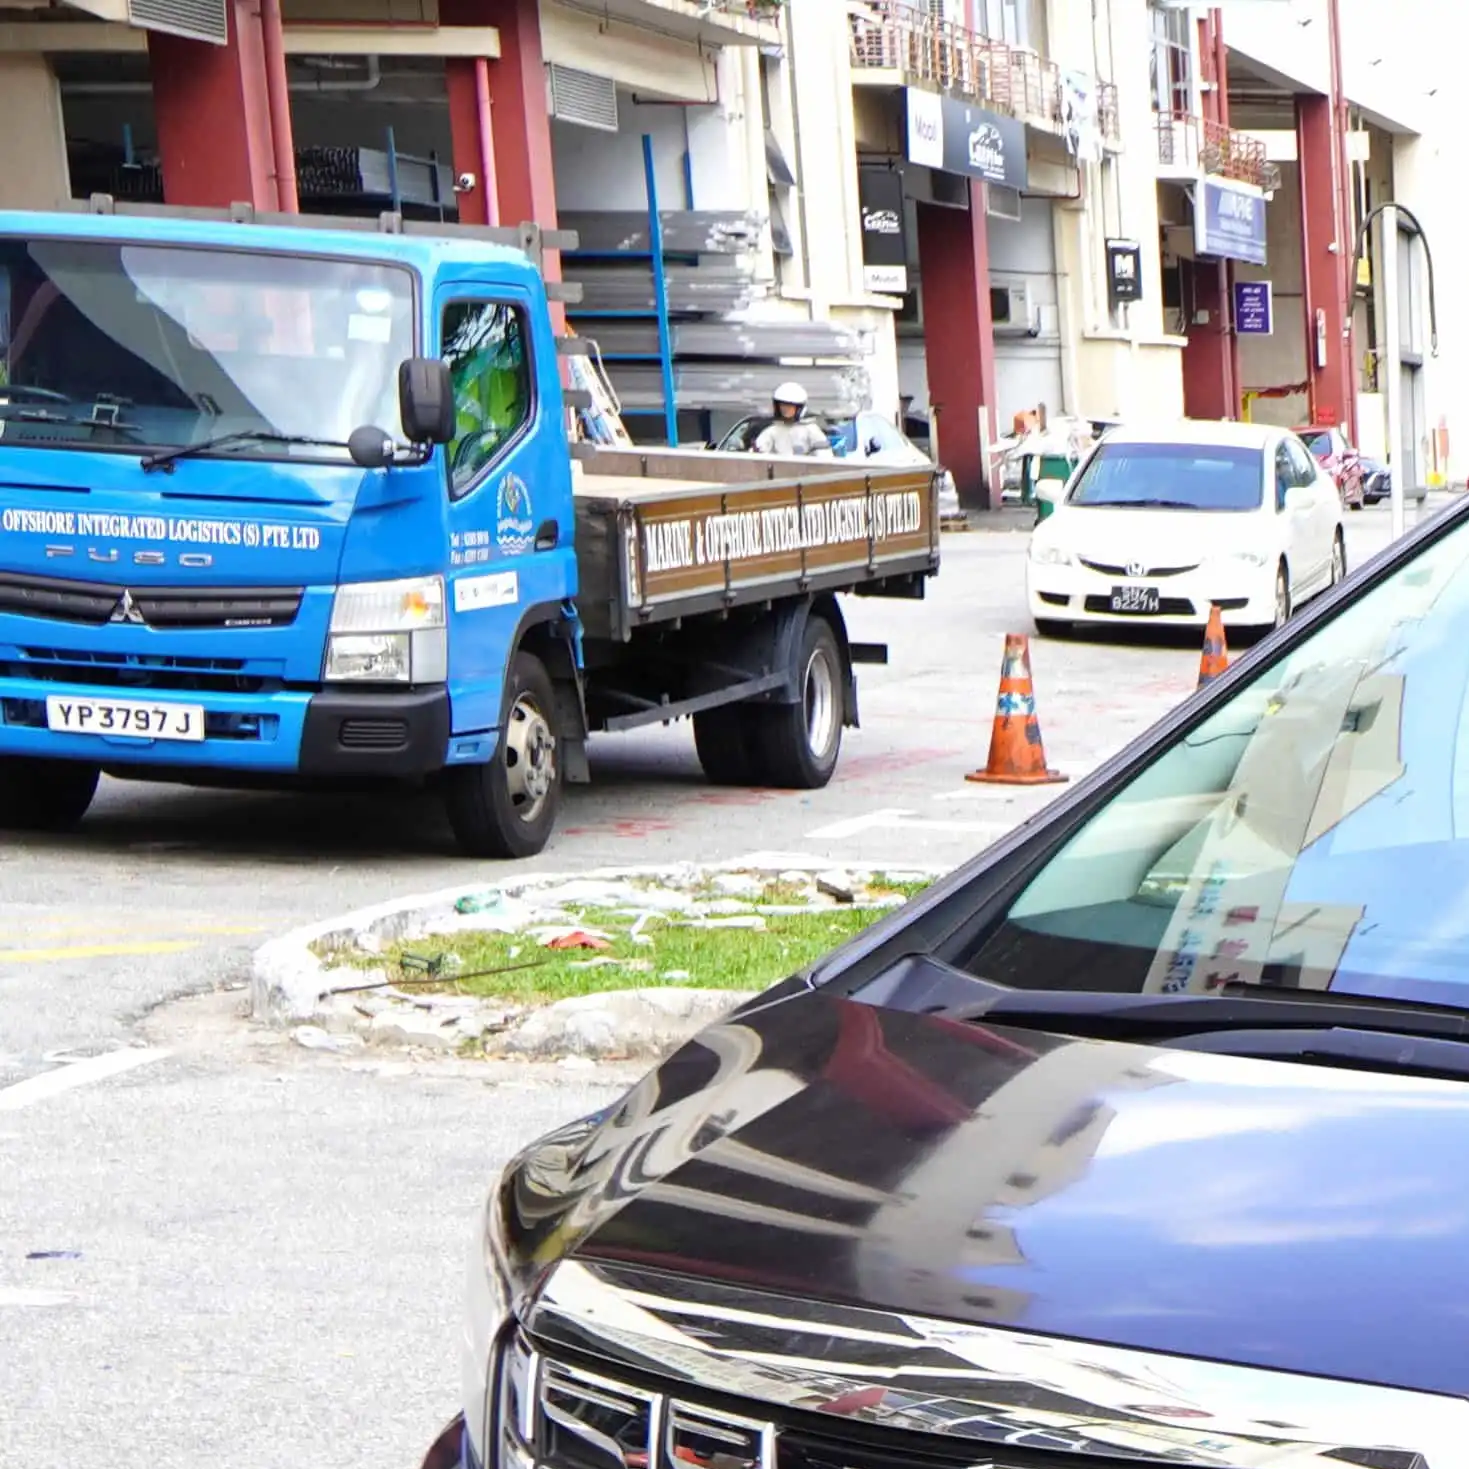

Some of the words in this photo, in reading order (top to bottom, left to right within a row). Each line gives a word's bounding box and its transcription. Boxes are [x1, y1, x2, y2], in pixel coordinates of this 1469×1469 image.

[2, 508, 75, 535] OFFSHORE
[77, 511, 166, 541] INTEGRATED
[168, 517, 241, 545] LOGISTICS
[242, 522, 260, 548] (S)
[262, 524, 290, 549] PTE
[292, 526, 320, 550] LTD
[645, 519, 693, 573] MARINE
[695, 519, 706, 566] &
[705, 510, 762, 564] OFFSHORE
[45, 544, 214, 568] FUSO
